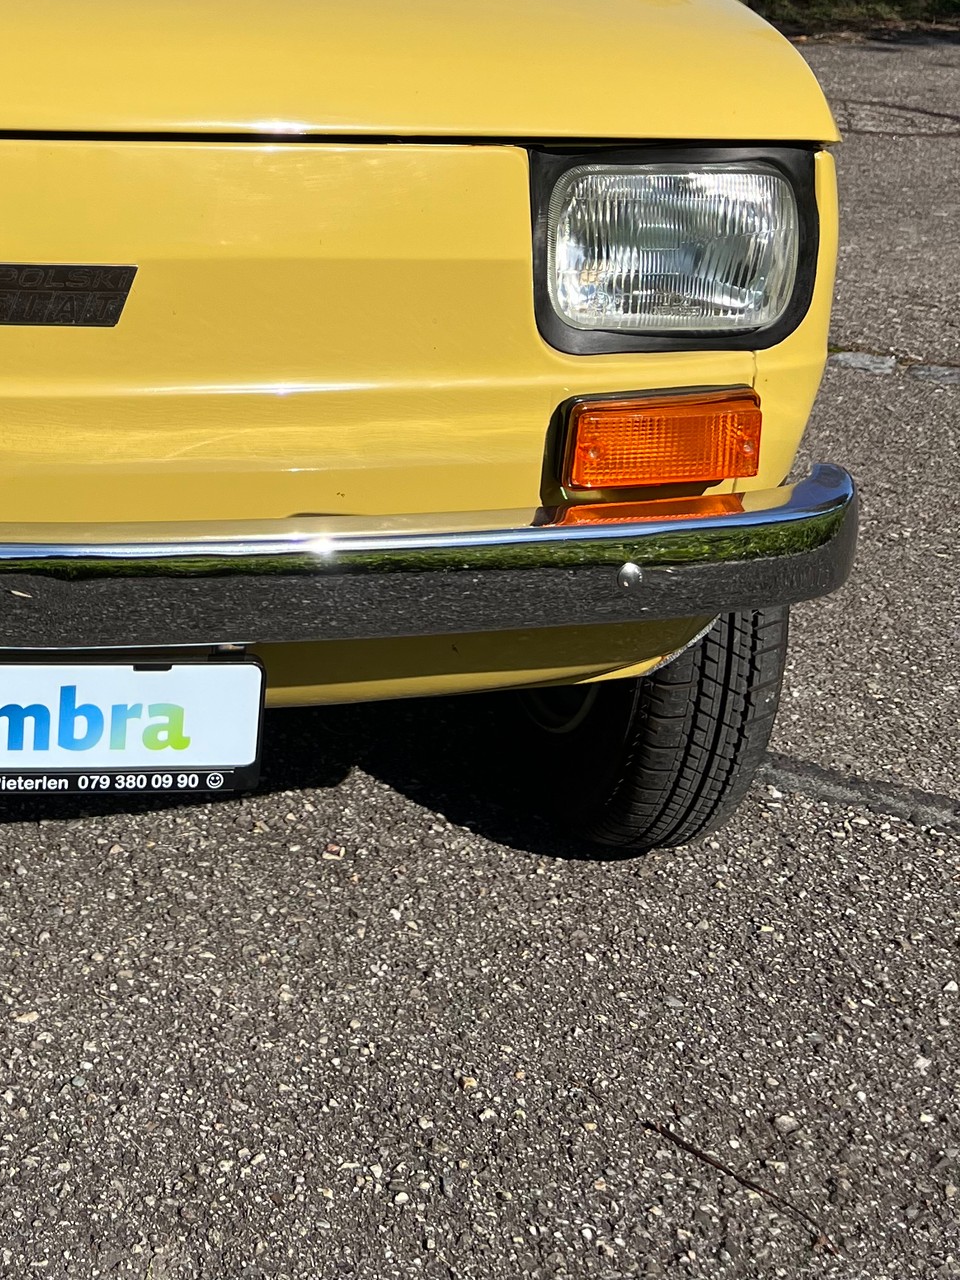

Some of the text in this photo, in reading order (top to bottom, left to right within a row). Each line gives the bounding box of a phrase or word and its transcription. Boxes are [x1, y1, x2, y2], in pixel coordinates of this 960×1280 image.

[77, 775, 110, 790] 079
[114, 774, 147, 790] 380
[151, 774, 173, 789] 09
[177, 774, 199, 789] 90
